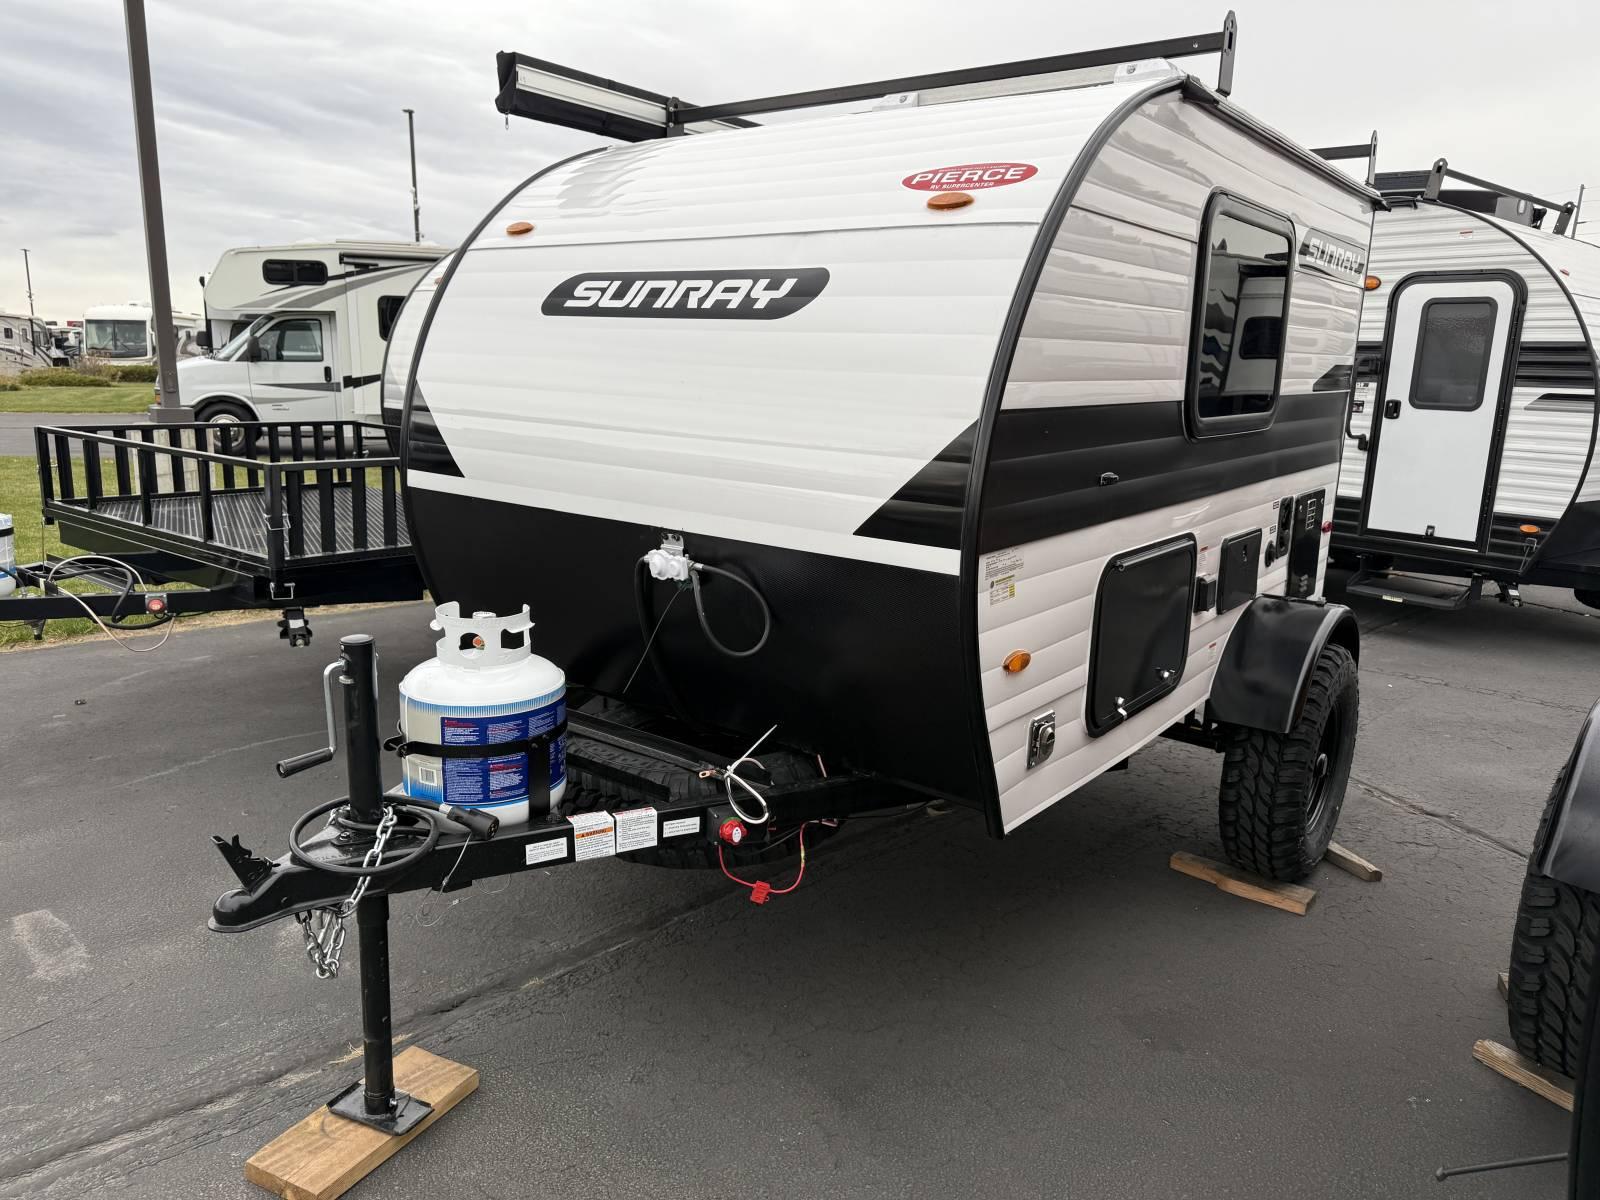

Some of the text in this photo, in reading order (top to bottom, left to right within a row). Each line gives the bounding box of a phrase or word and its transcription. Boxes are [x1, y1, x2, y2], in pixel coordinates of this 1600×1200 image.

[911, 166, 1027, 185] PIERCE
[942, 181, 995, 189] SUPERCENTER
[1306, 237, 1361, 275] SUNRAY
[563, 278, 798, 309] SUNRAY
